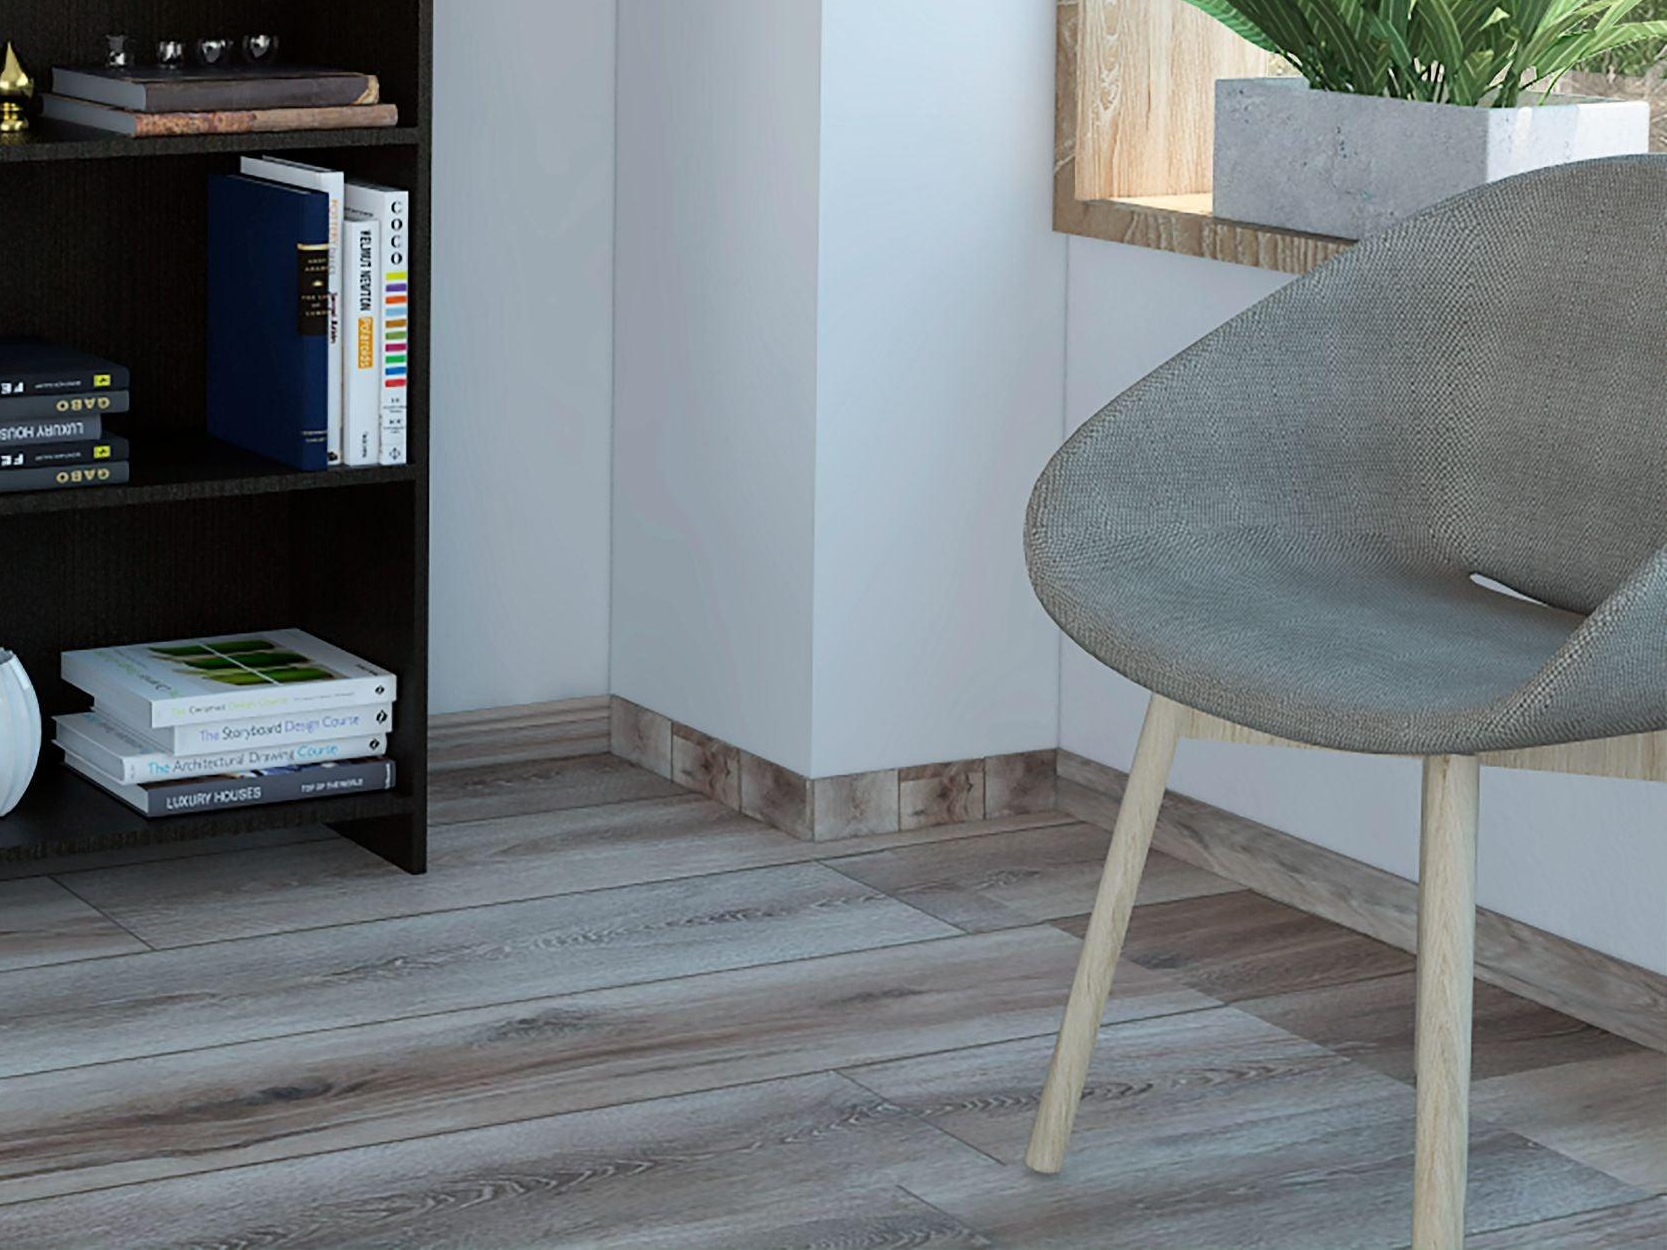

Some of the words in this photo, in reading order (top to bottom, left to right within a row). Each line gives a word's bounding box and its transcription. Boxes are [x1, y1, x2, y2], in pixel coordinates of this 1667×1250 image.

[360, 230, 372, 268] HELMUT
[391, 201, 403, 266] COCO
[360, 270, 372, 312] NEWTON
[36, 421, 84, 438] LUXURY
[199, 730, 221, 743] The
[222, 723, 282, 740] Storyboard
[284, 719, 319, 734] Design
[322, 715, 360, 728] Course
[148, 761, 171, 775] The
[173, 753, 245, 772] Architectural
[249, 750, 295, 764] Drawing
[297, 744, 339, 758] Course
[166, 792, 213, 810] LUXURY
[213, 786, 261, 803] HOUSES
